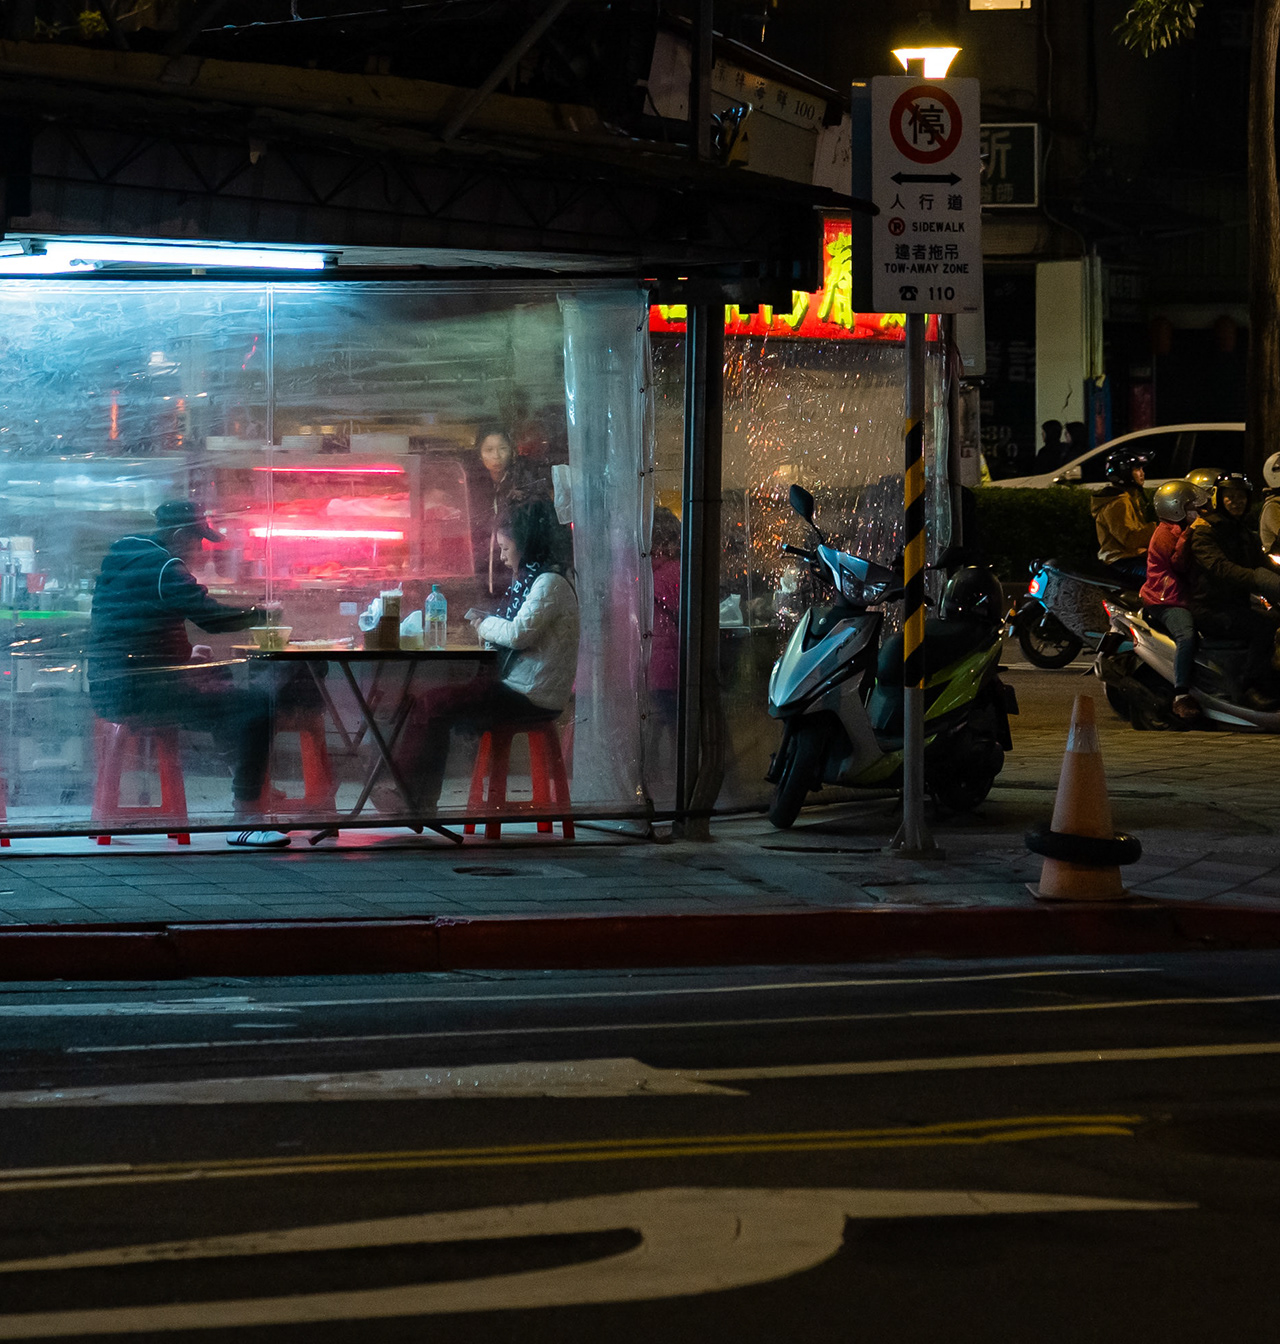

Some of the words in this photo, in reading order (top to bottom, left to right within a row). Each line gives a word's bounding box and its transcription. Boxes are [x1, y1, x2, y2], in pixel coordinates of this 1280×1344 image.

[795, 100, 815, 120] 100
[908, 104, 945, 145] 停
[890, 194, 963, 211] 人行道
[911, 222, 965, 233] SIDEWALK
[894, 244, 959, 261] 違者拖吊
[884, 263, 938, 274] TOW-AWAY
[942, 263, 969, 274] ZONE
[928, 286, 955, 301] 110
